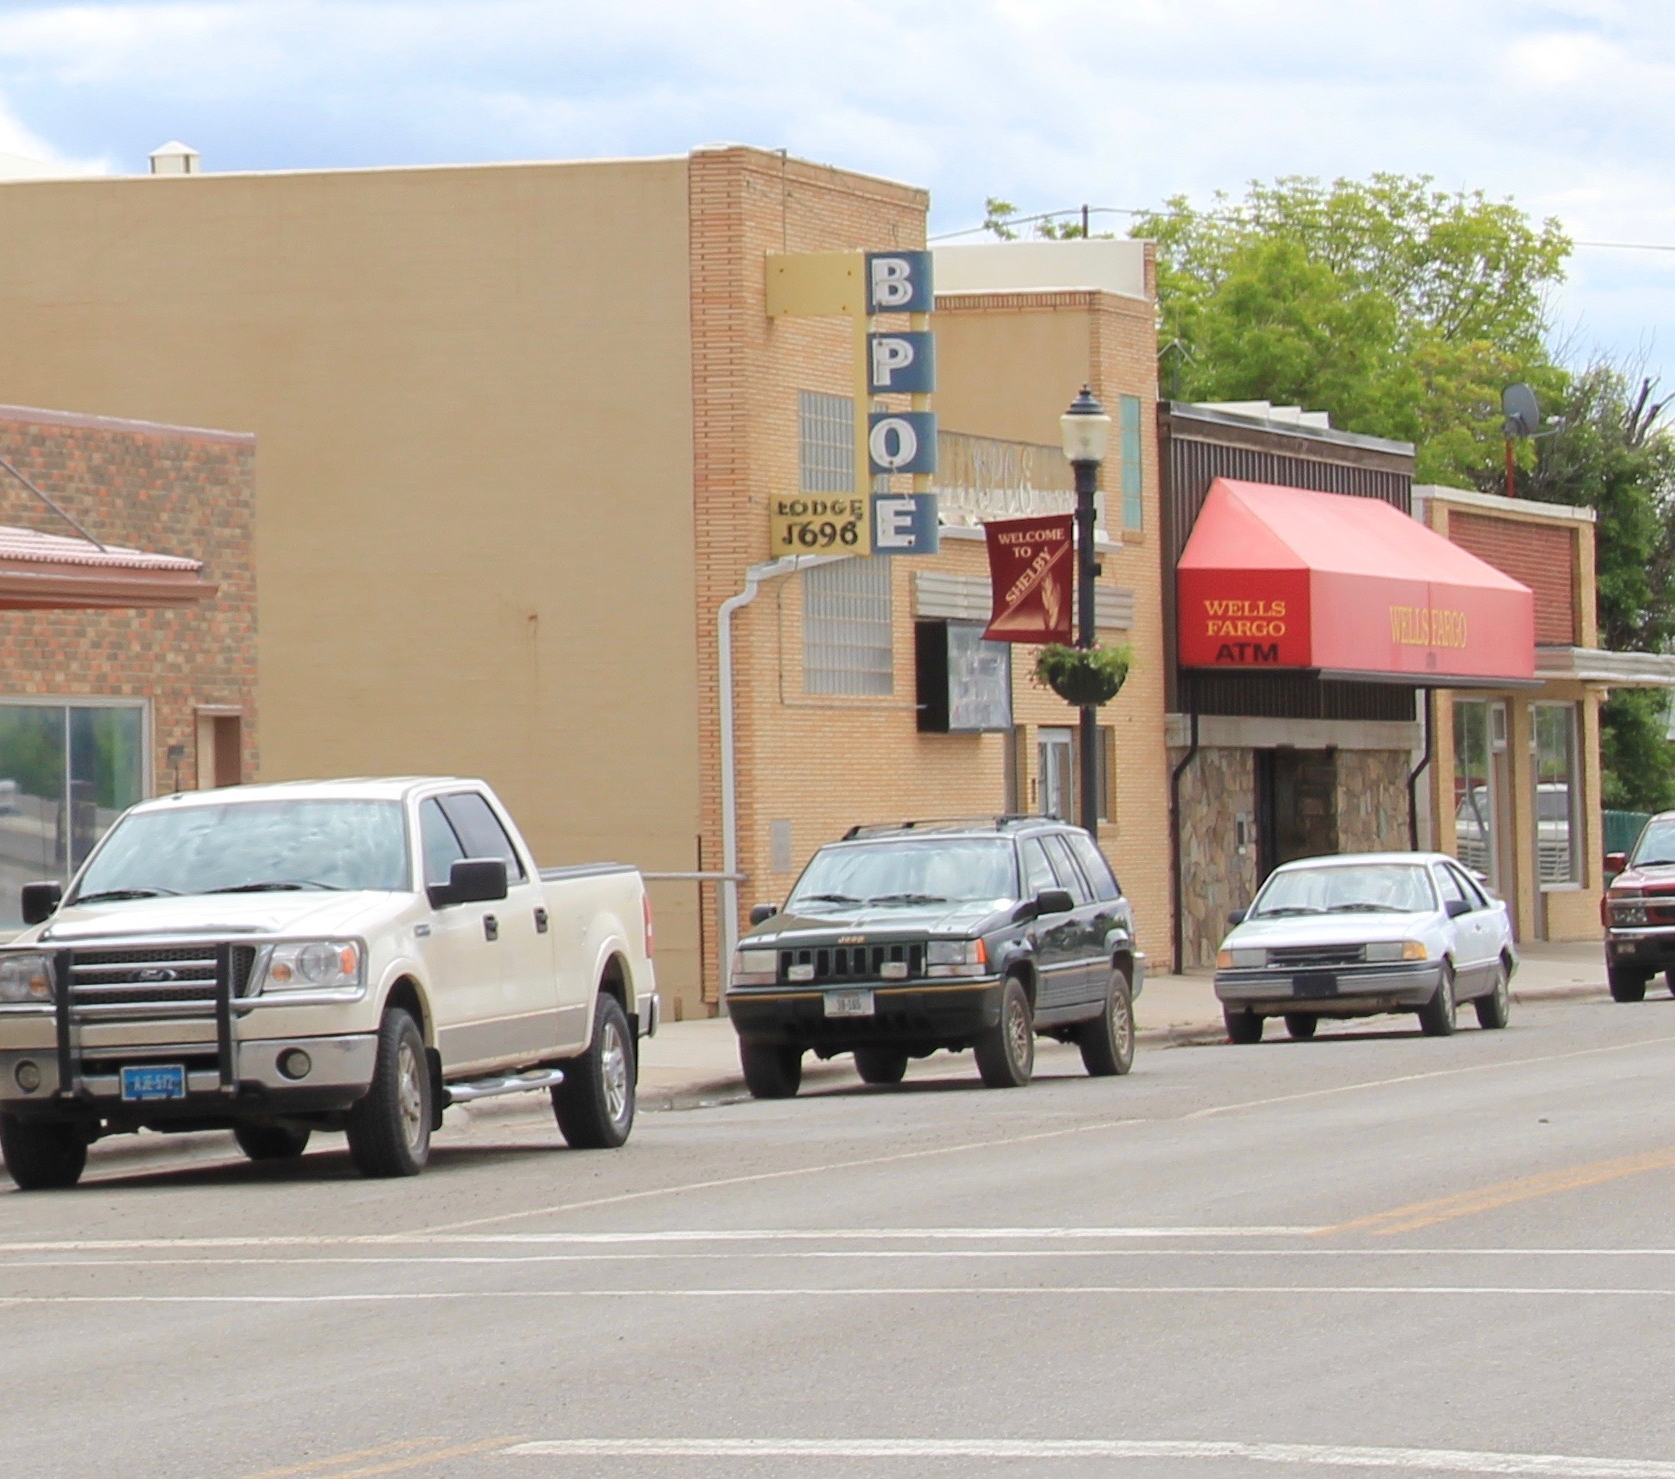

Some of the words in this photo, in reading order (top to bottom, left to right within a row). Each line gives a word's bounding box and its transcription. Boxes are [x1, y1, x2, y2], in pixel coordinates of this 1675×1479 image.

[778, 500, 863, 520] LODGE
[998, 528, 1065, 545] WELCOME
[1013, 546, 1031, 559] TO
[1005, 546, 1053, 605] SHELBY
[1204, 600, 1286, 617] WELLS
[1206, 620, 1287, 637] FARGO
[1390, 605, 1430, 646] WELLS
[1431, 610, 1468, 649] FARGO
[1215, 642, 1279, 663] ATM
